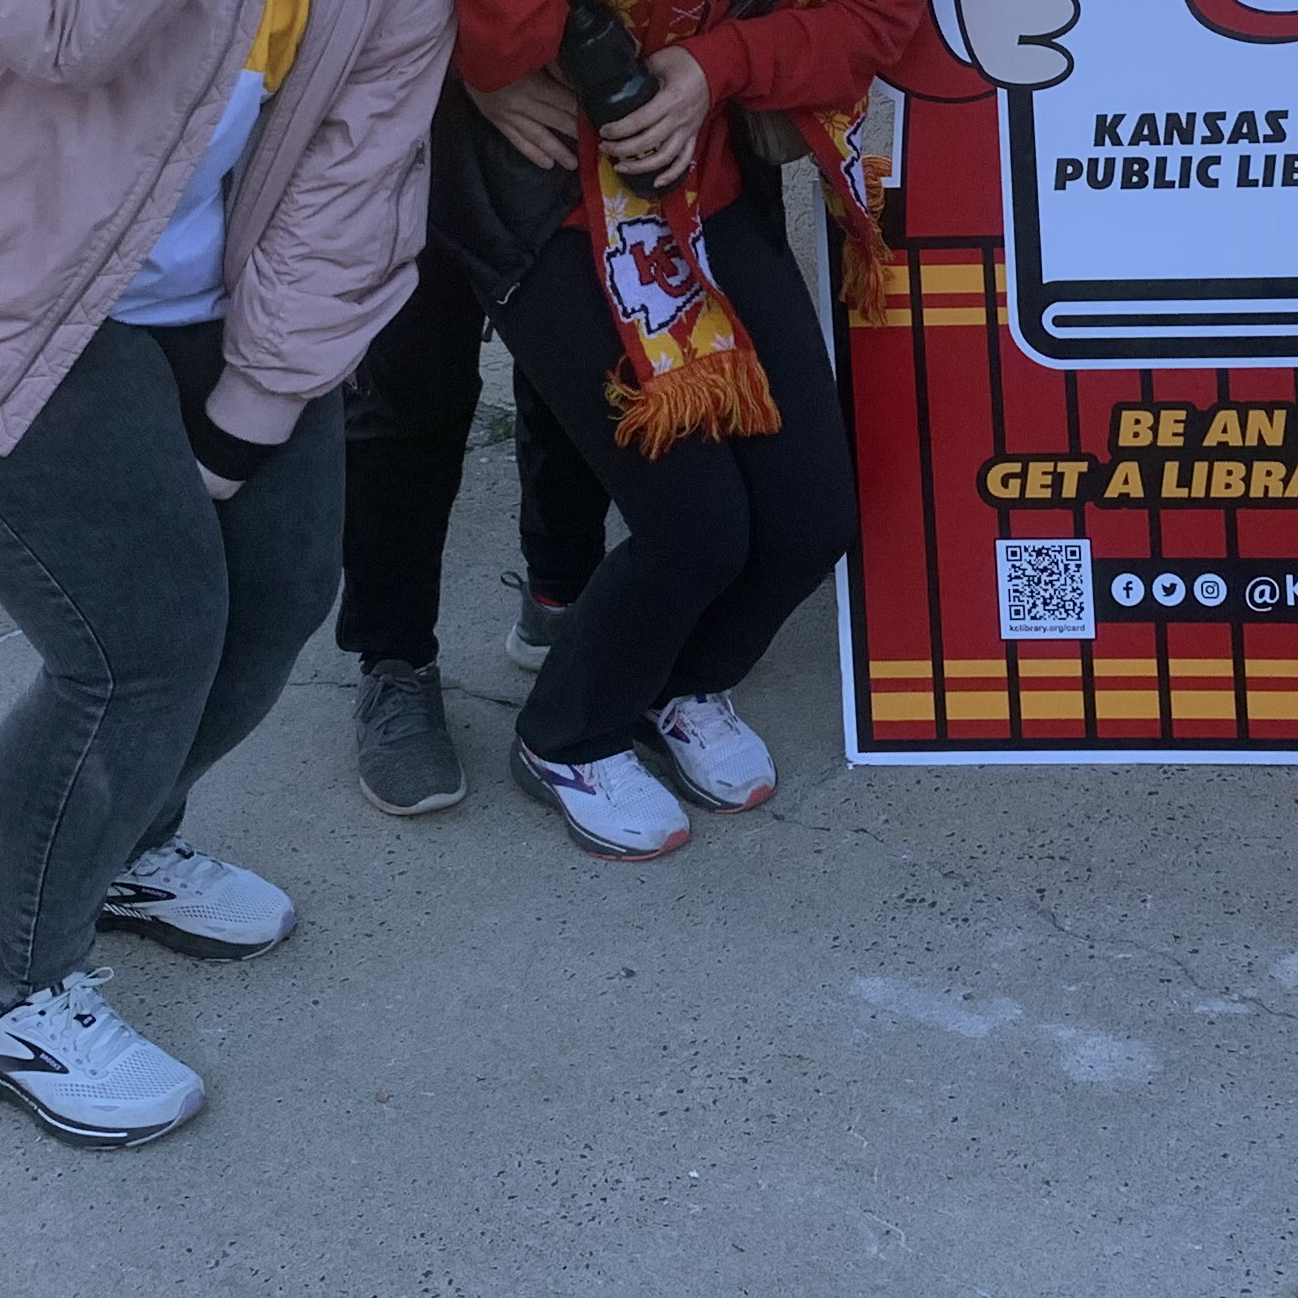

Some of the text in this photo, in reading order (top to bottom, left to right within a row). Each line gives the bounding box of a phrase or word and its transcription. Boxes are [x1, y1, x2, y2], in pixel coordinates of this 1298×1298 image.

[1093, 109, 1289, 147] KANSAS
[1054, 154, 1222, 191] PUBLIC
[1117, 409, 1190, 447] BE
[1203, 409, 1287, 447] AN
[985, 461, 1089, 499] GET
[1104, 461, 1145, 498] A
[1009, 624, 1086, 633] kclibrary.org/card
